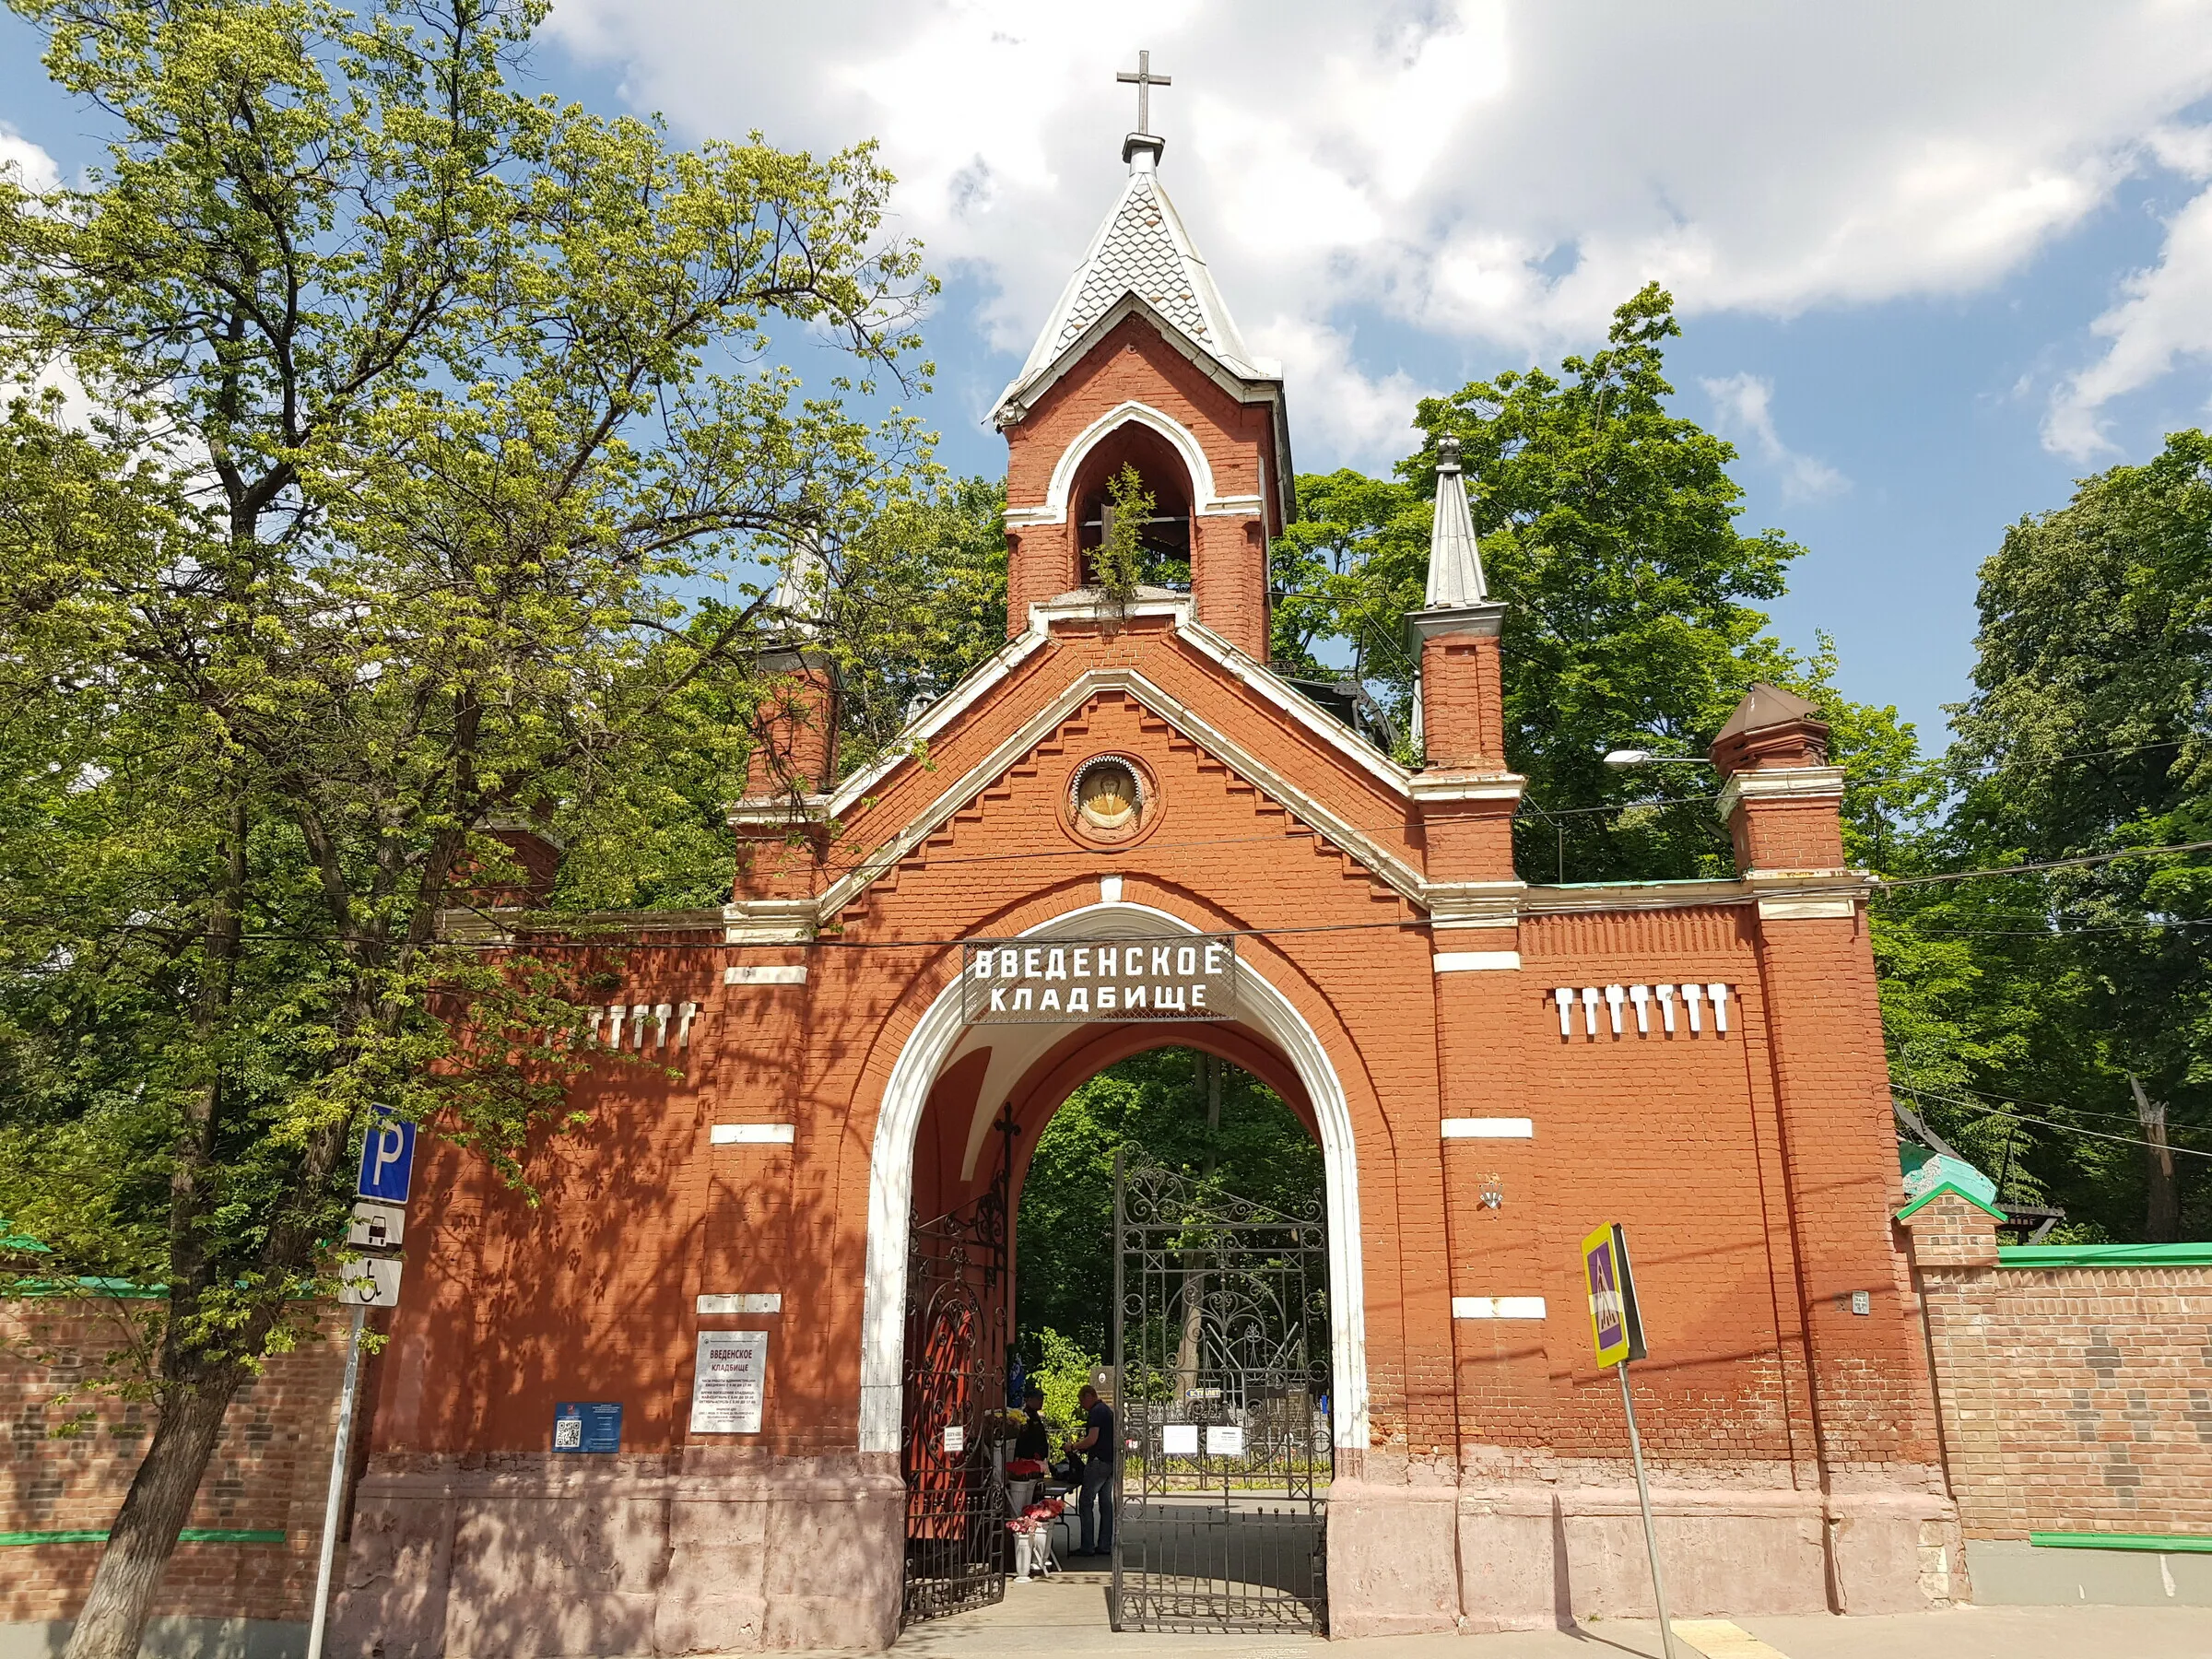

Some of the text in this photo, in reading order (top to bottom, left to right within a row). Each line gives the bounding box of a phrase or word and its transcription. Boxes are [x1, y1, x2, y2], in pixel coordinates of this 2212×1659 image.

[974, 944, 1223, 980] ВВЕДЕНСКОЕ
[990, 984, 1206, 1013] КЛАДБИЩЕ
[372, 1118, 404, 1185] P
[710, 1349, 752, 1360] ВВЕДЕНСКОЕ
[712, 1364, 748, 1372] КЛАДБИЩЕ
